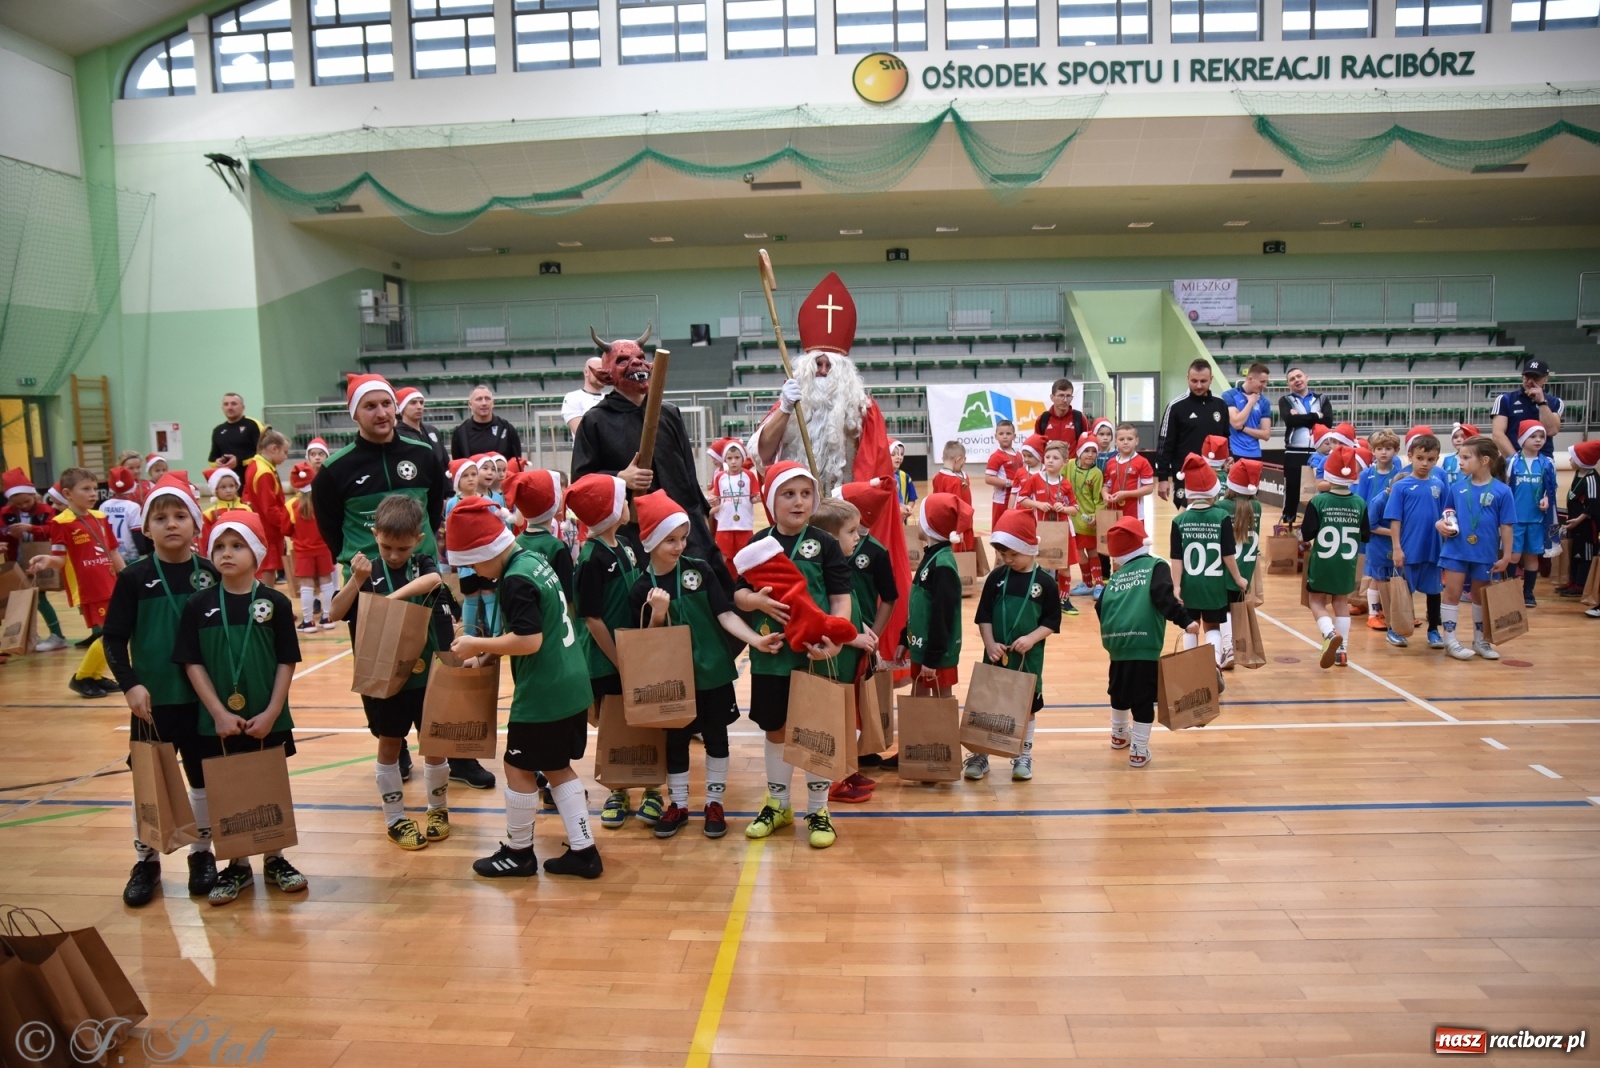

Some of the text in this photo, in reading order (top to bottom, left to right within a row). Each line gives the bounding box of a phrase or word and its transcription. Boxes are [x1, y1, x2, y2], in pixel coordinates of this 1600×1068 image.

[922, 47, 1475, 90] OŚRODEK SPORTU I REKREACJI RACIBÓRZ
[1181, 281, 1231, 292] MIESZKO
[957, 434, 995, 446] powiat
[965, 447, 991, 455] elona
[1324, 516, 1359, 524] TWORKÓW
[1181, 531, 1219, 540] TWORKÓW
[1317, 525, 1360, 560] 95
[1183, 541, 1223, 577] 02
